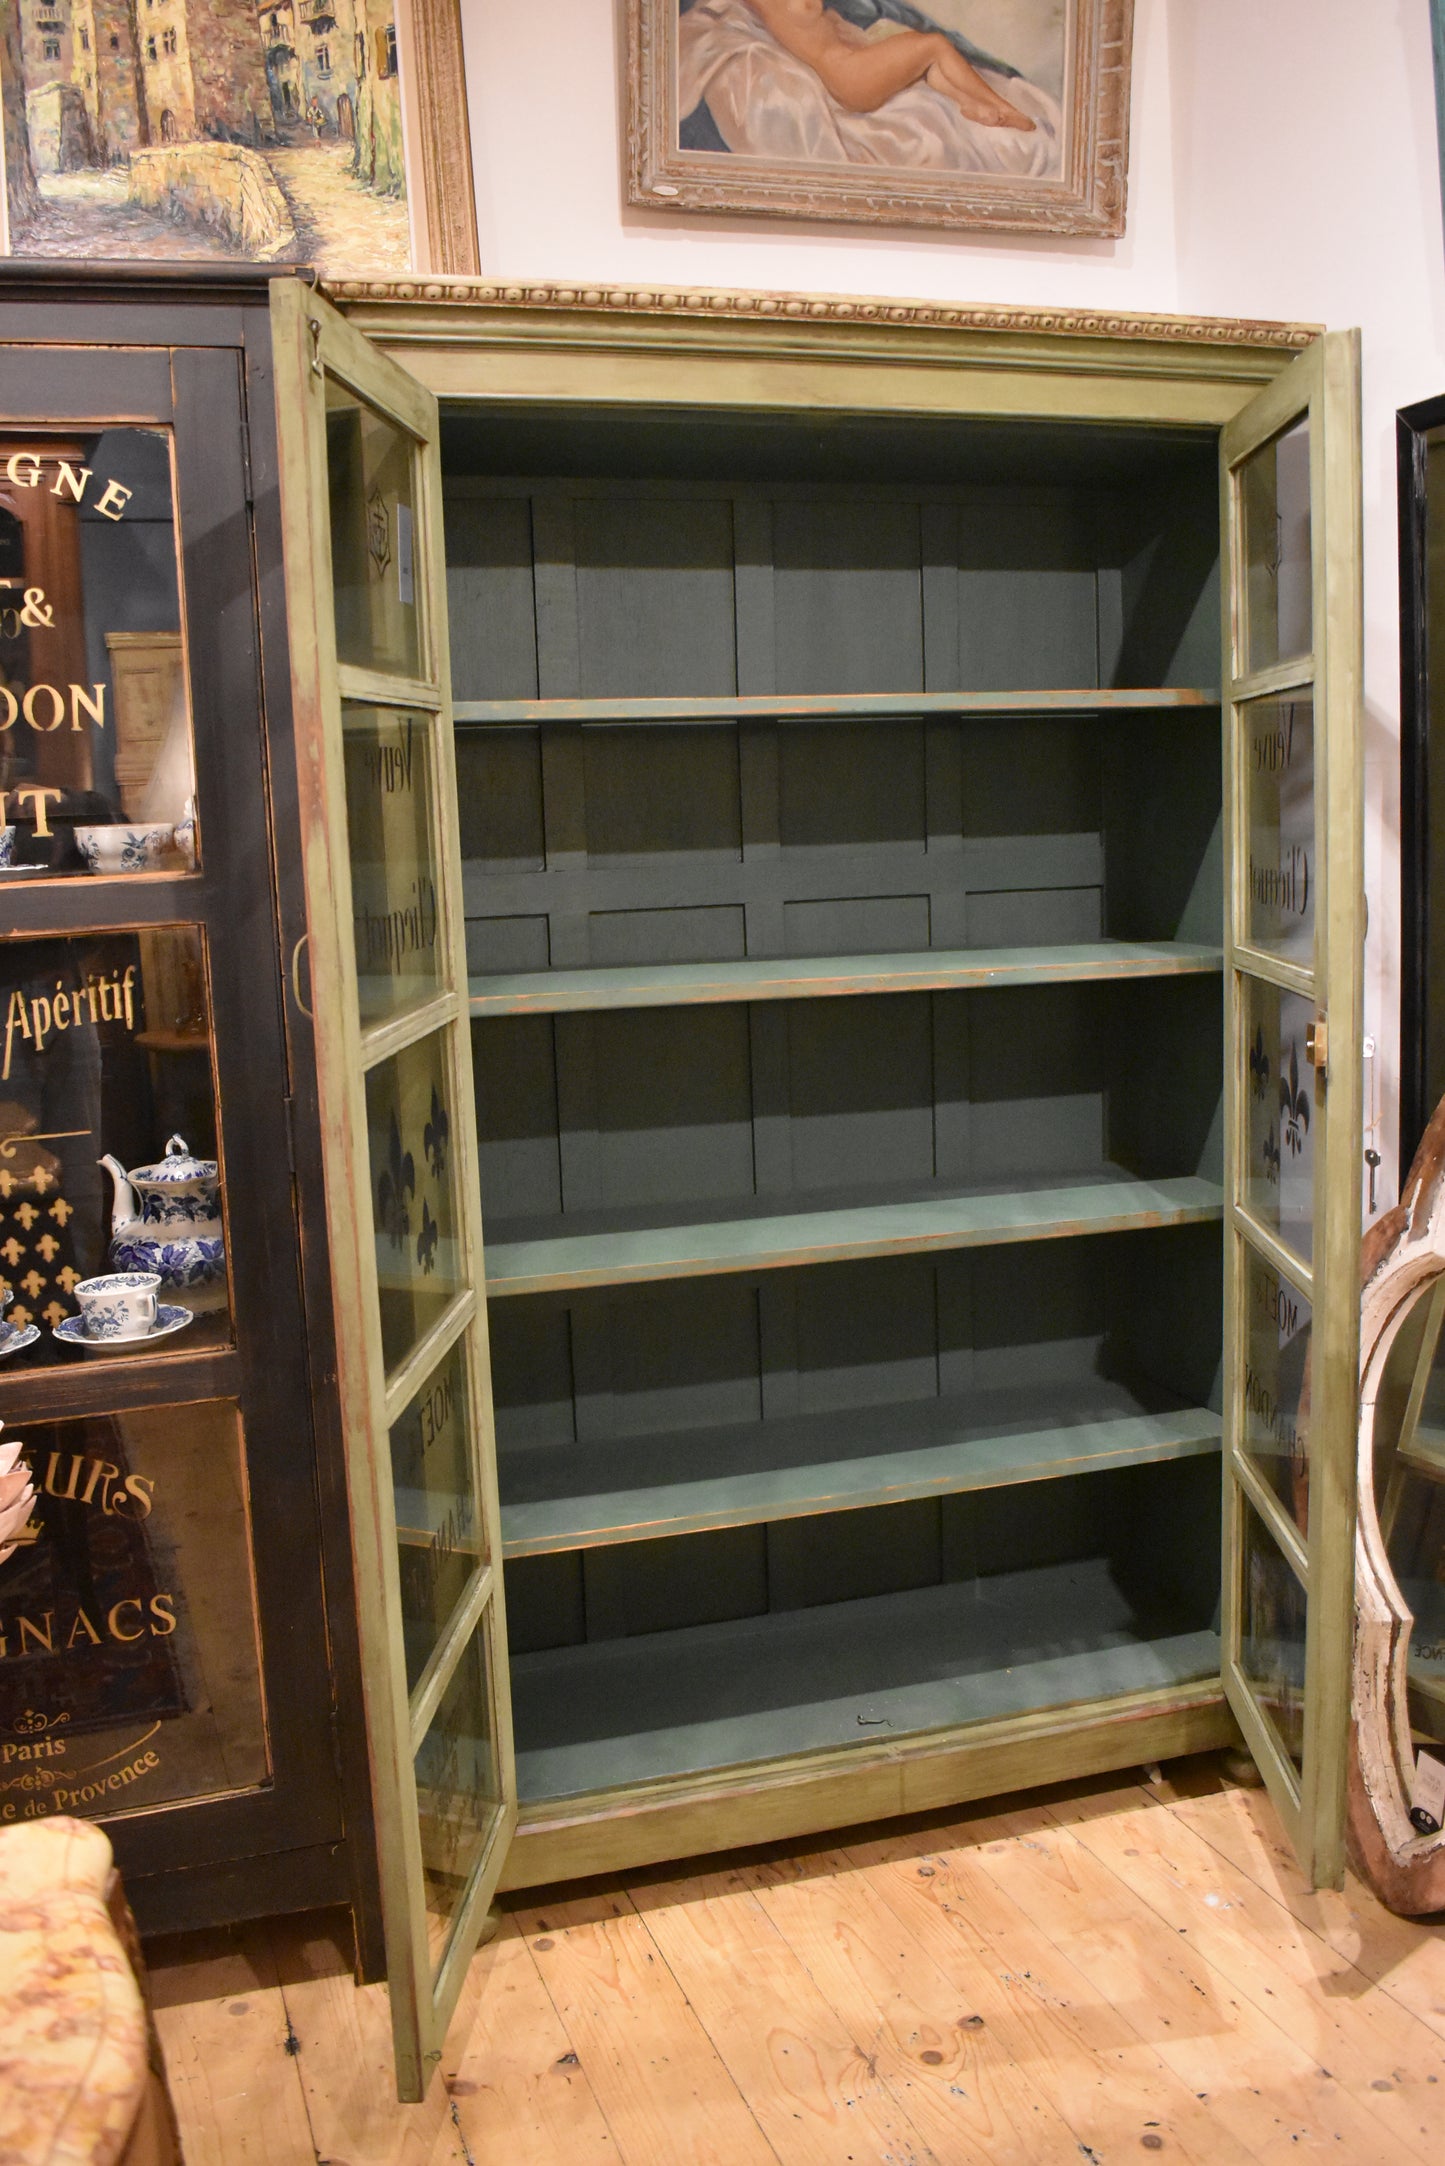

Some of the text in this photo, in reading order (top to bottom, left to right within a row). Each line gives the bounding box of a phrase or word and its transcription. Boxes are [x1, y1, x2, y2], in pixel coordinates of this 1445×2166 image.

[20, 587, 55, 628] &
[0, 789, 62, 838] T
[2, 965, 136, 1080] Apéritif
[0, 1594, 177, 1659] NACS
[2, 1736, 66, 1764] Paris
[24, 1799, 47, 1817] de
[52, 1751, 160, 1811] Provence
